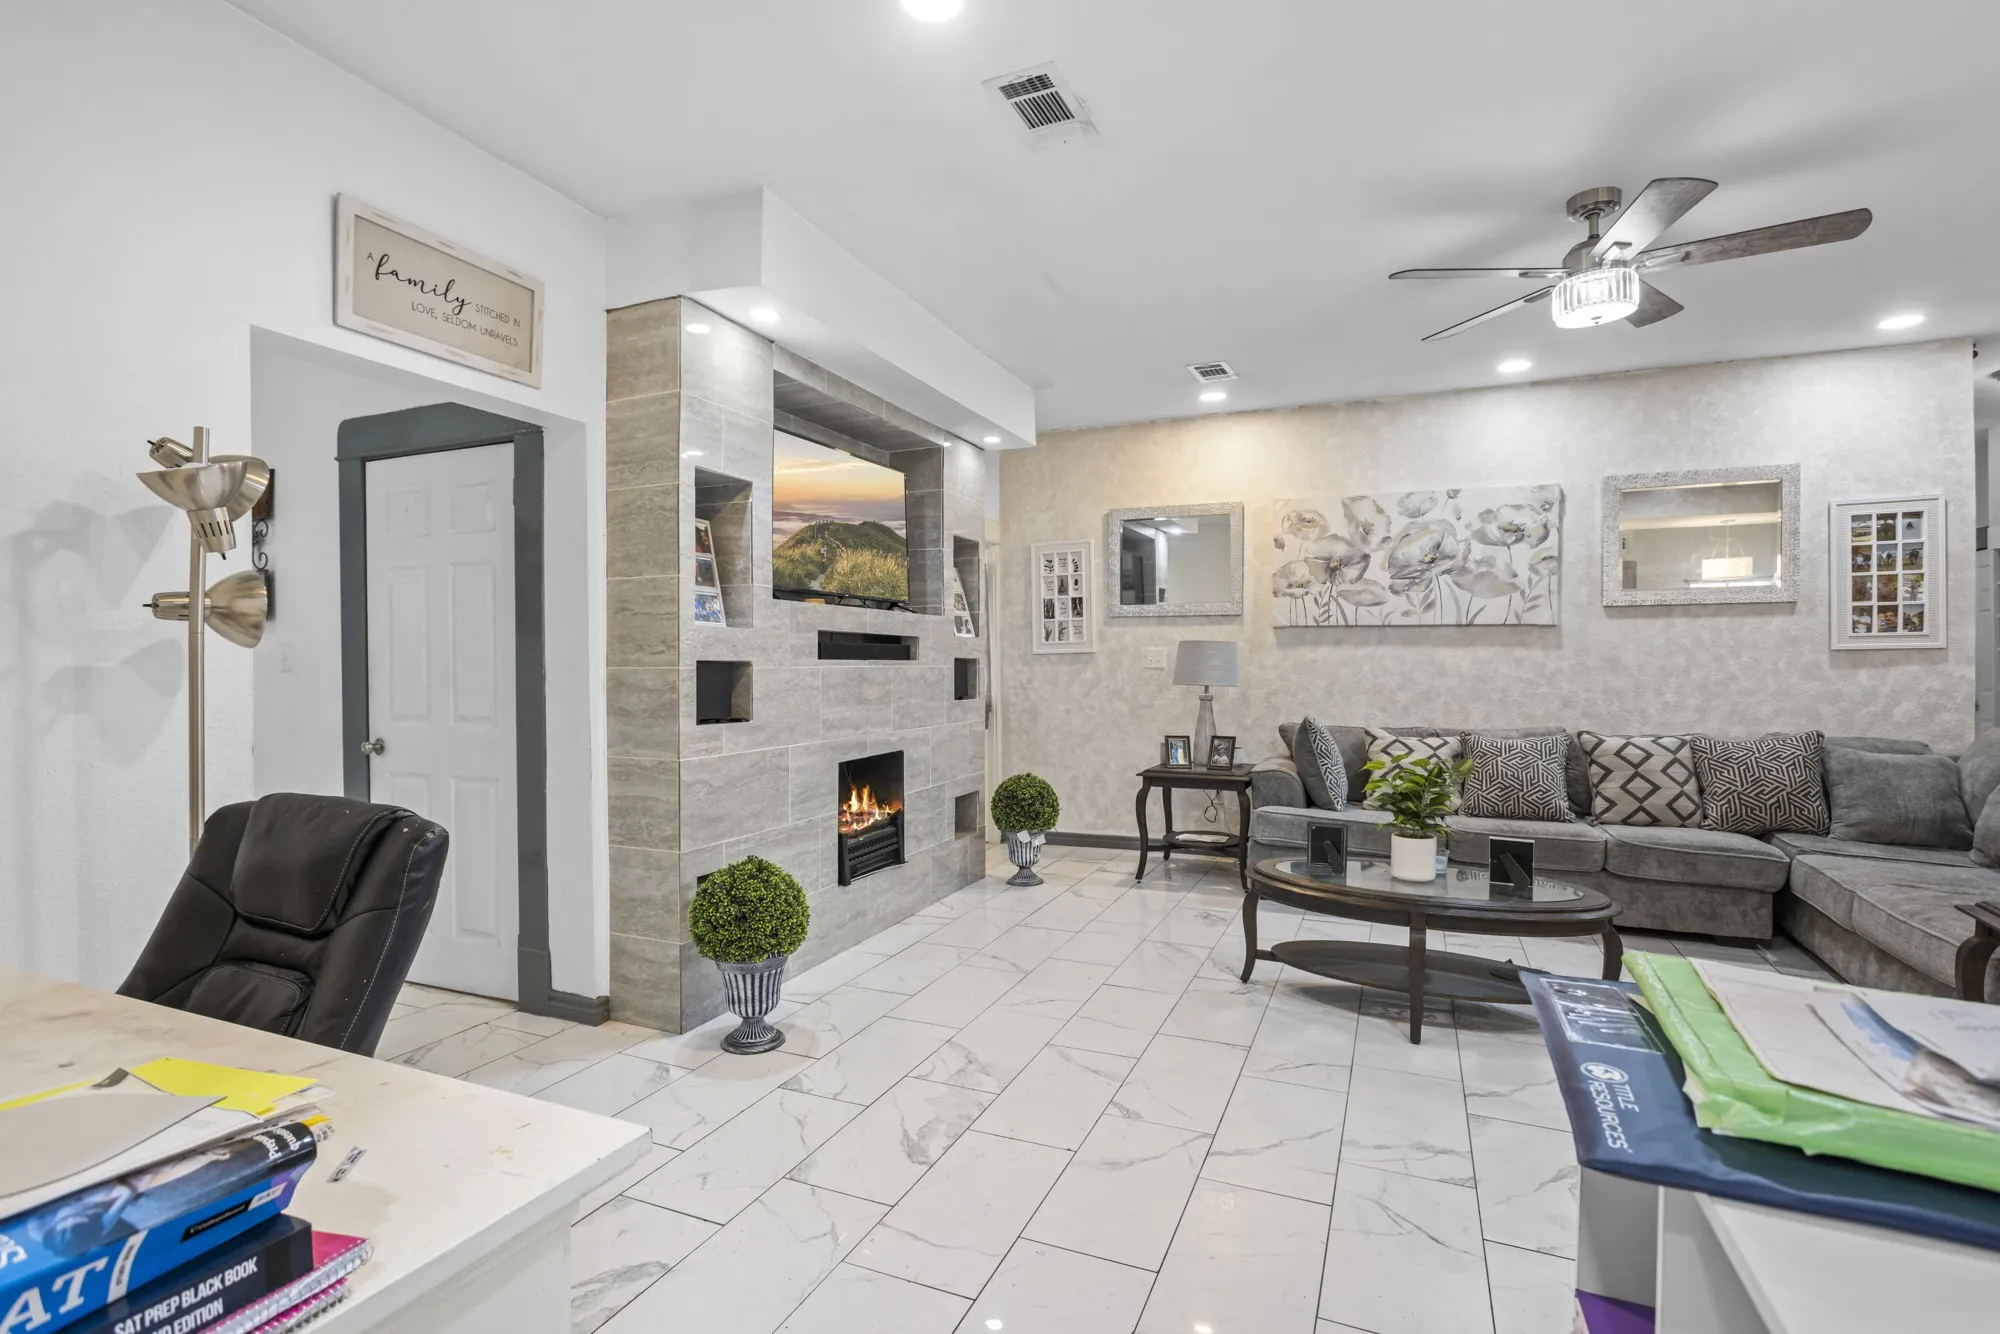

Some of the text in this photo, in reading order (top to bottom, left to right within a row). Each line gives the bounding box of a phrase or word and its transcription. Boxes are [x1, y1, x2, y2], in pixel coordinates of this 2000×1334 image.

[366, 252, 521, 328] A family STITCHED IN
[411, 301, 518, 347] LOVE, SELDOM UNRAVELS
[1587, 1079, 1629, 1149] RESOURCES
[1612, 1084, 1640, 1113] TITLE
[114, 1256, 258, 1334] SAT PREP BLACK BOOK
[173, 1297, 224, 1334] EDITION
